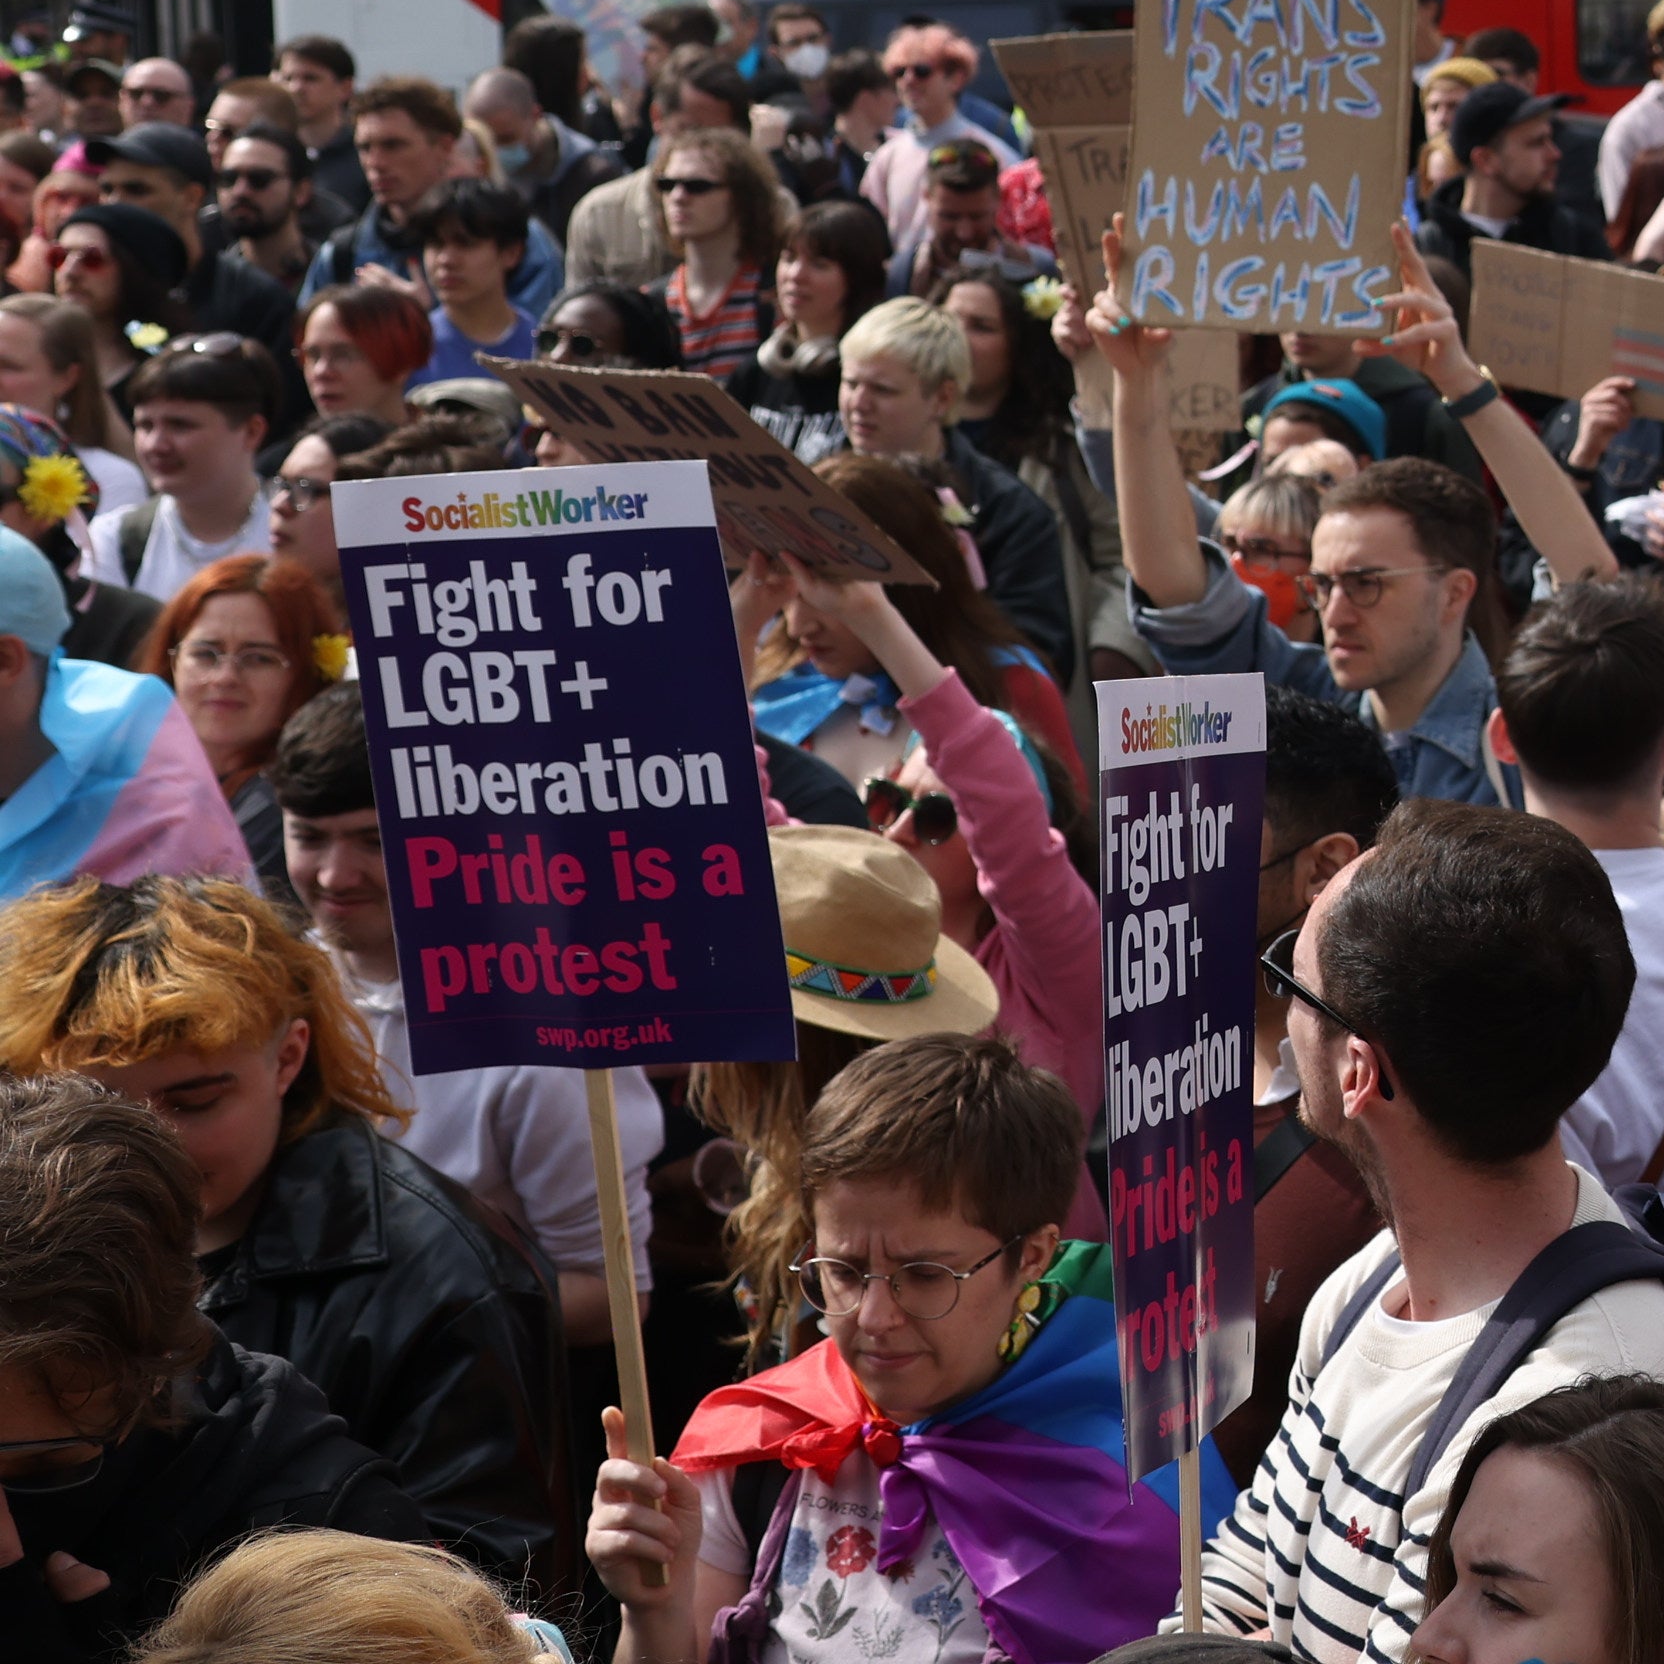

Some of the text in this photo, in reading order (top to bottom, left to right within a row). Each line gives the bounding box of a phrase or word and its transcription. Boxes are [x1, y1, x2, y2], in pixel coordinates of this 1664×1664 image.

[1183, 40, 1383, 121] RIGHTS
[1200, 121, 1308, 176] ARE
[1135, 166, 1361, 251] HUMAN
[1130, 244, 1392, 330] RIGHTS
[363, 553, 673, 648] Fight for
[377, 648, 609, 730] LGBT+
[389, 736, 729, 820] liberation
[403, 829, 744, 910] Pride is a
[1105, 782, 1234, 907] Fight for
[418, 921, 678, 1014] protest
[1106, 902, 1203, 1020] LGBT+
[535, 1016, 673, 1052] swp.org.uk
[1108, 1012, 1242, 1144] liberation
[1111, 1131, 1243, 1268] Pride is a
[801, 1492, 868, 1519] FLOWERS
